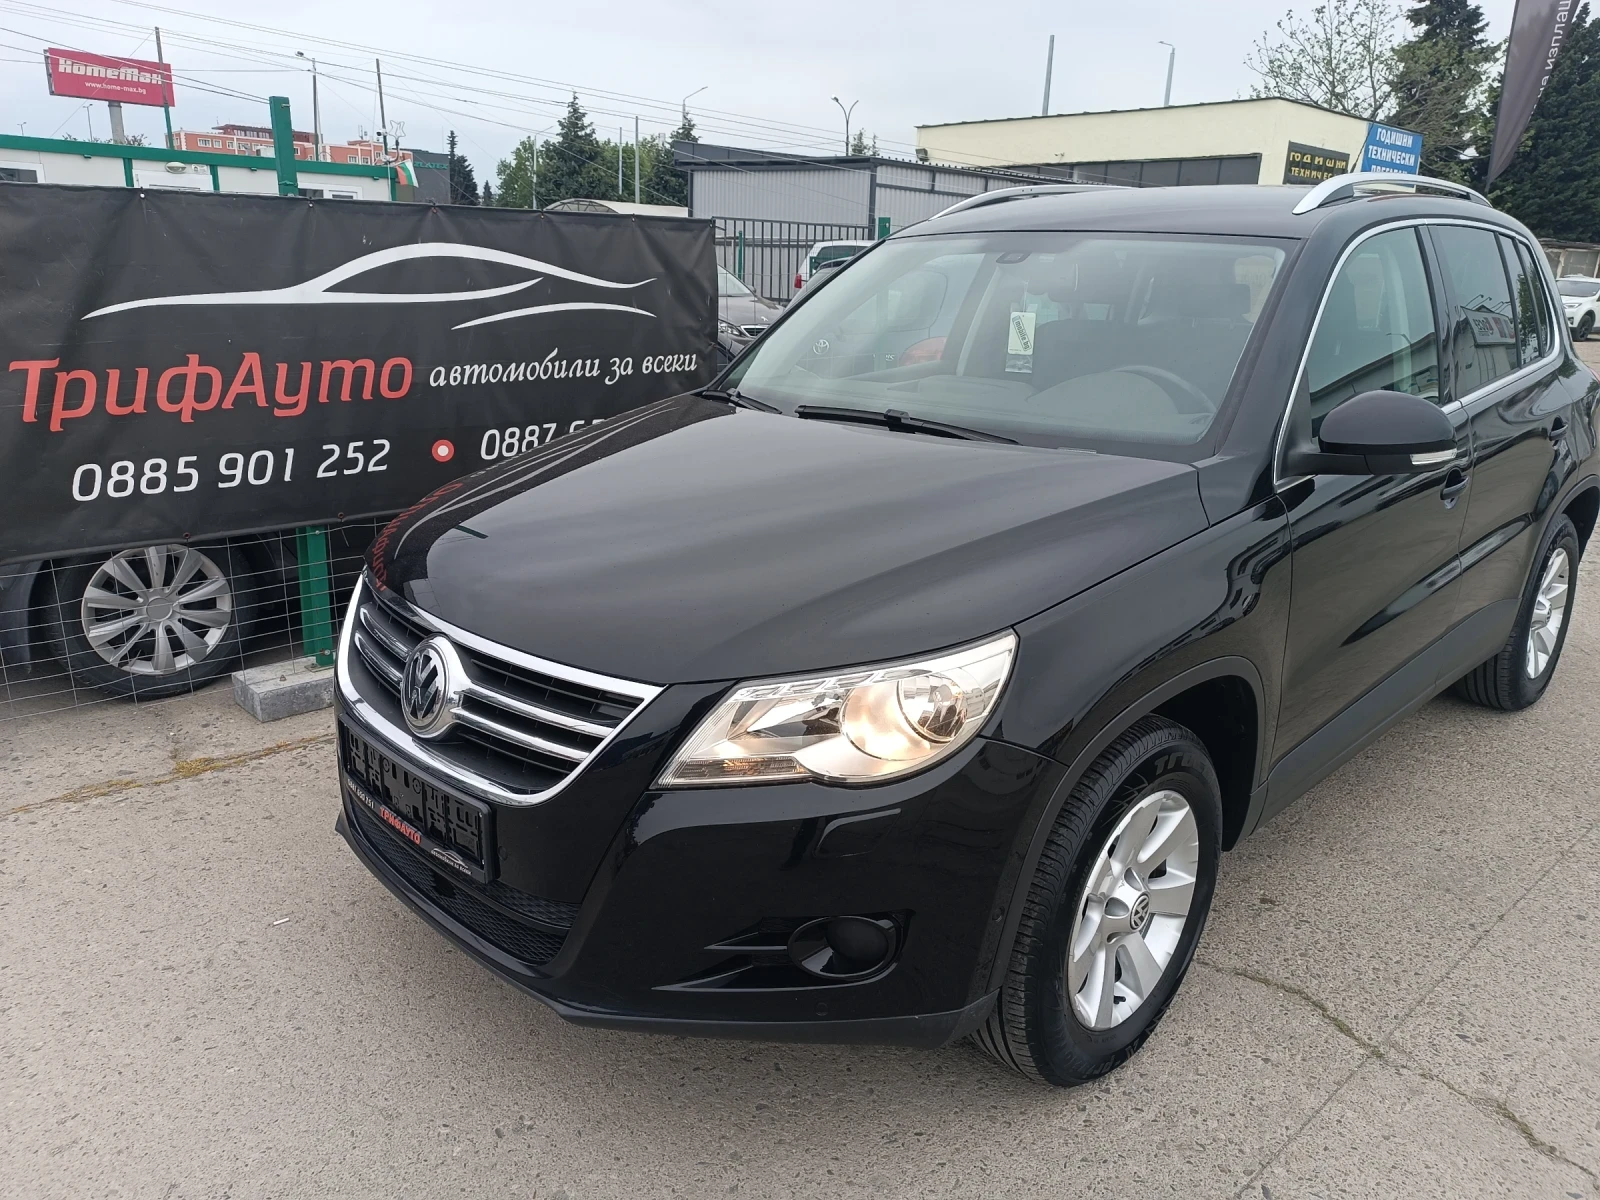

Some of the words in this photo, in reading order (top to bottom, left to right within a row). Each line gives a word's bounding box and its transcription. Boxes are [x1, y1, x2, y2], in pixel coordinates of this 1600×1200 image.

[84, 81, 147, 95] www.home-max.bg
[1376, 127, 1413, 148] ГОДИШНИ
[1290, 152, 1347, 169] ГОДИШНИ
[1368, 145, 1416, 167] ТЕХНИЧЕСКИ
[1291, 167, 1336, 180] ТЕХНИЧЕС
[429, 347, 601, 387] автомобили
[604, 356, 634, 385] за
[641, 352, 698, 375] всеки
[8, 352, 413, 432] ТрифАуто
[480, 422, 557, 460] 0887
[72, 455, 200, 501] 0885
[217, 447, 295, 488] 901
[316, 438, 391, 478] 252
[379, 807, 421, 845] ТРИФАУТО
